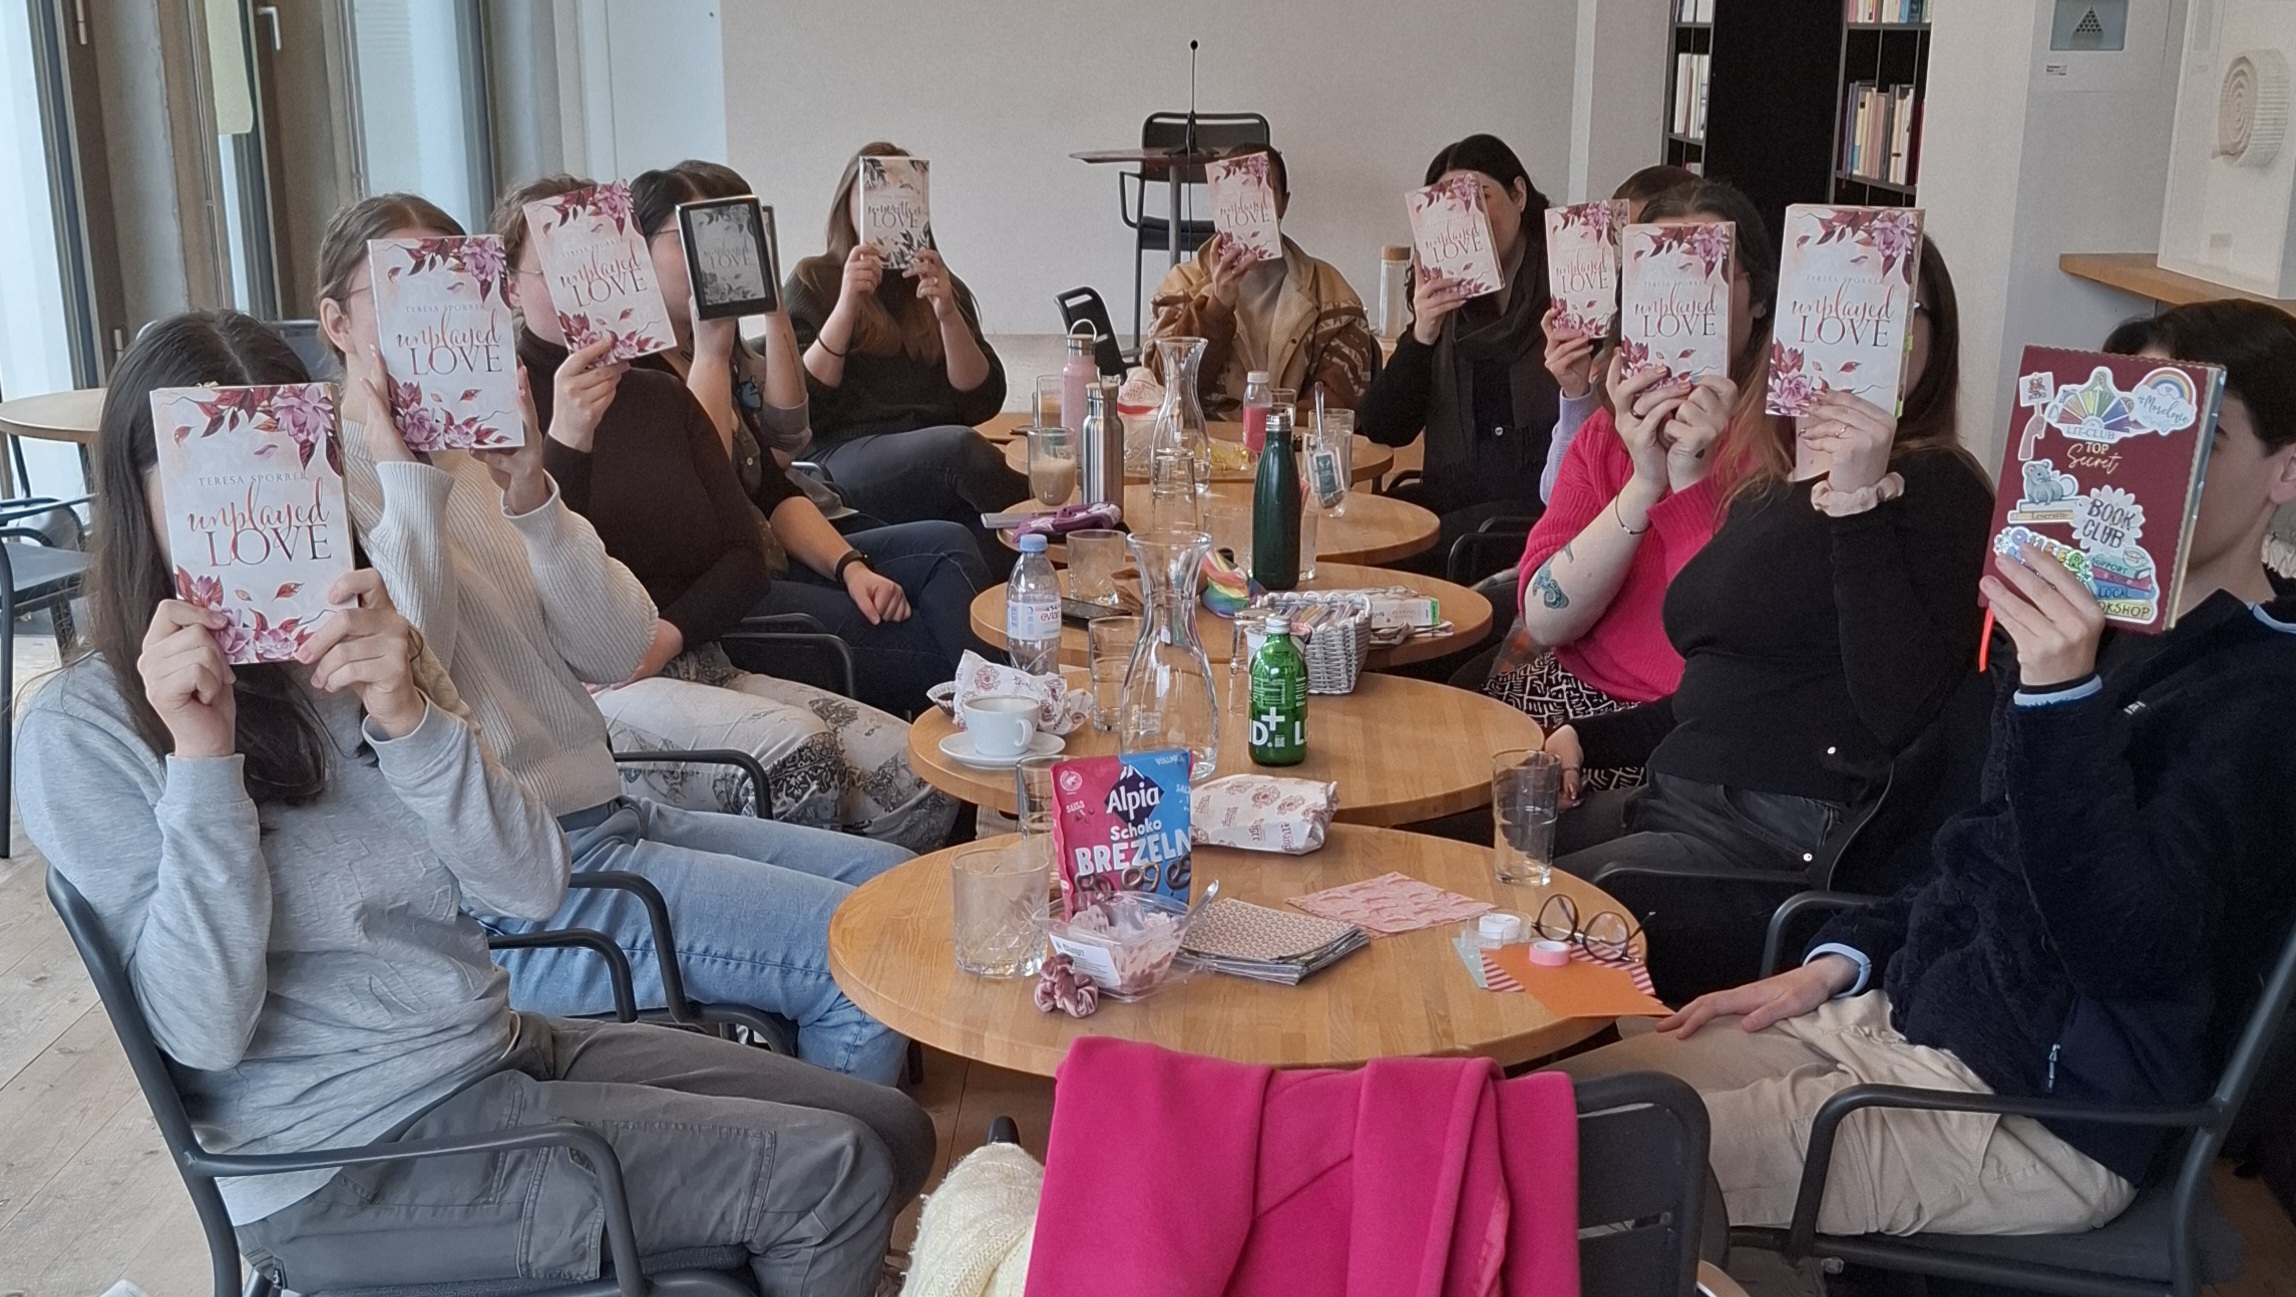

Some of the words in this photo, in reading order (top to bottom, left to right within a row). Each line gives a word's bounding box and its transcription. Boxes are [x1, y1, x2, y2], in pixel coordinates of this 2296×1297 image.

[873, 211, 918, 228] LOVE
[1226, 204, 1270, 228] LOVE
[1433, 232, 1483, 263] LOVE
[572, 268, 647, 307] LOVE
[1562, 270, 1609, 293] LOVE
[1634, 284, 1718, 328] unplayed
[1792, 284, 1895, 334] unplayed
[397, 308, 501, 368] unplayed
[1643, 313, 1716, 338] LOVE
[1799, 315, 1890, 347] LOVE
[410, 345, 502, 375] LOVE
[2066, 425, 2115, 439] LIT-CLUB
[2067, 443, 2123, 474] Secret
[2085, 441, 2110, 454] TOP
[198, 475, 244, 487] TERESA
[250, 471, 307, 482] SPORRER
[188, 477, 329, 556] unplayed
[2088, 498, 2137, 530] BOOK
[205, 524, 331, 567] LOVE
[2082, 521, 2125, 548] CLUB
[2093, 557, 2128, 574] SUPPORT
[2098, 586, 2132, 598] LOCAL
[1040, 609, 1060, 622] evia
[2097, 601, 2150, 618] OKSHOP
[1106, 781, 1160, 820] Alpia
[1110, 818, 1162, 841] Schoko
[1075, 826, 1191, 876] BREZELN
